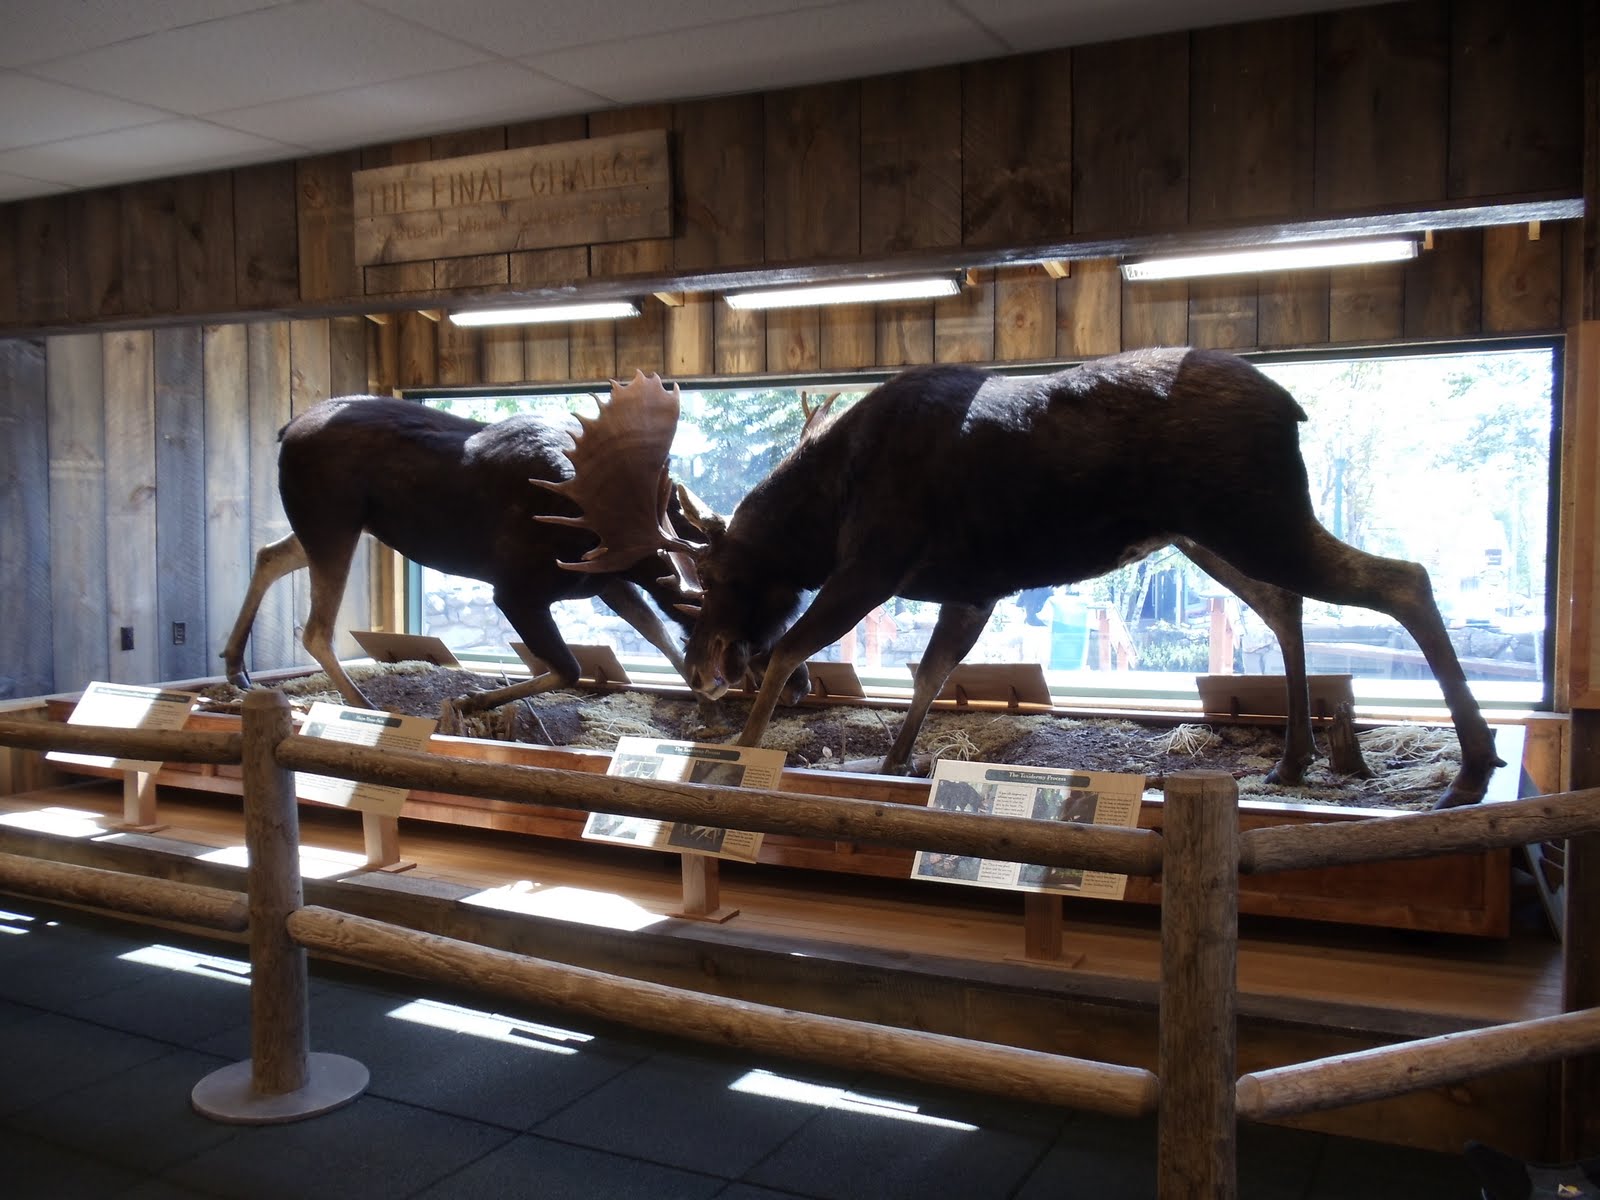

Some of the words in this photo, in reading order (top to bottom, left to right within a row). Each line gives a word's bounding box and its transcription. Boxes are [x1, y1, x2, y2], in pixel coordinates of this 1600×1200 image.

[365, 181, 412, 215] THE
[431, 168, 513, 208] FINAL
[529, 152, 650, 196] CHARGE
[1020, 772, 1046, 781] Taxidermy
[1046, 774, 1067, 782] Process
